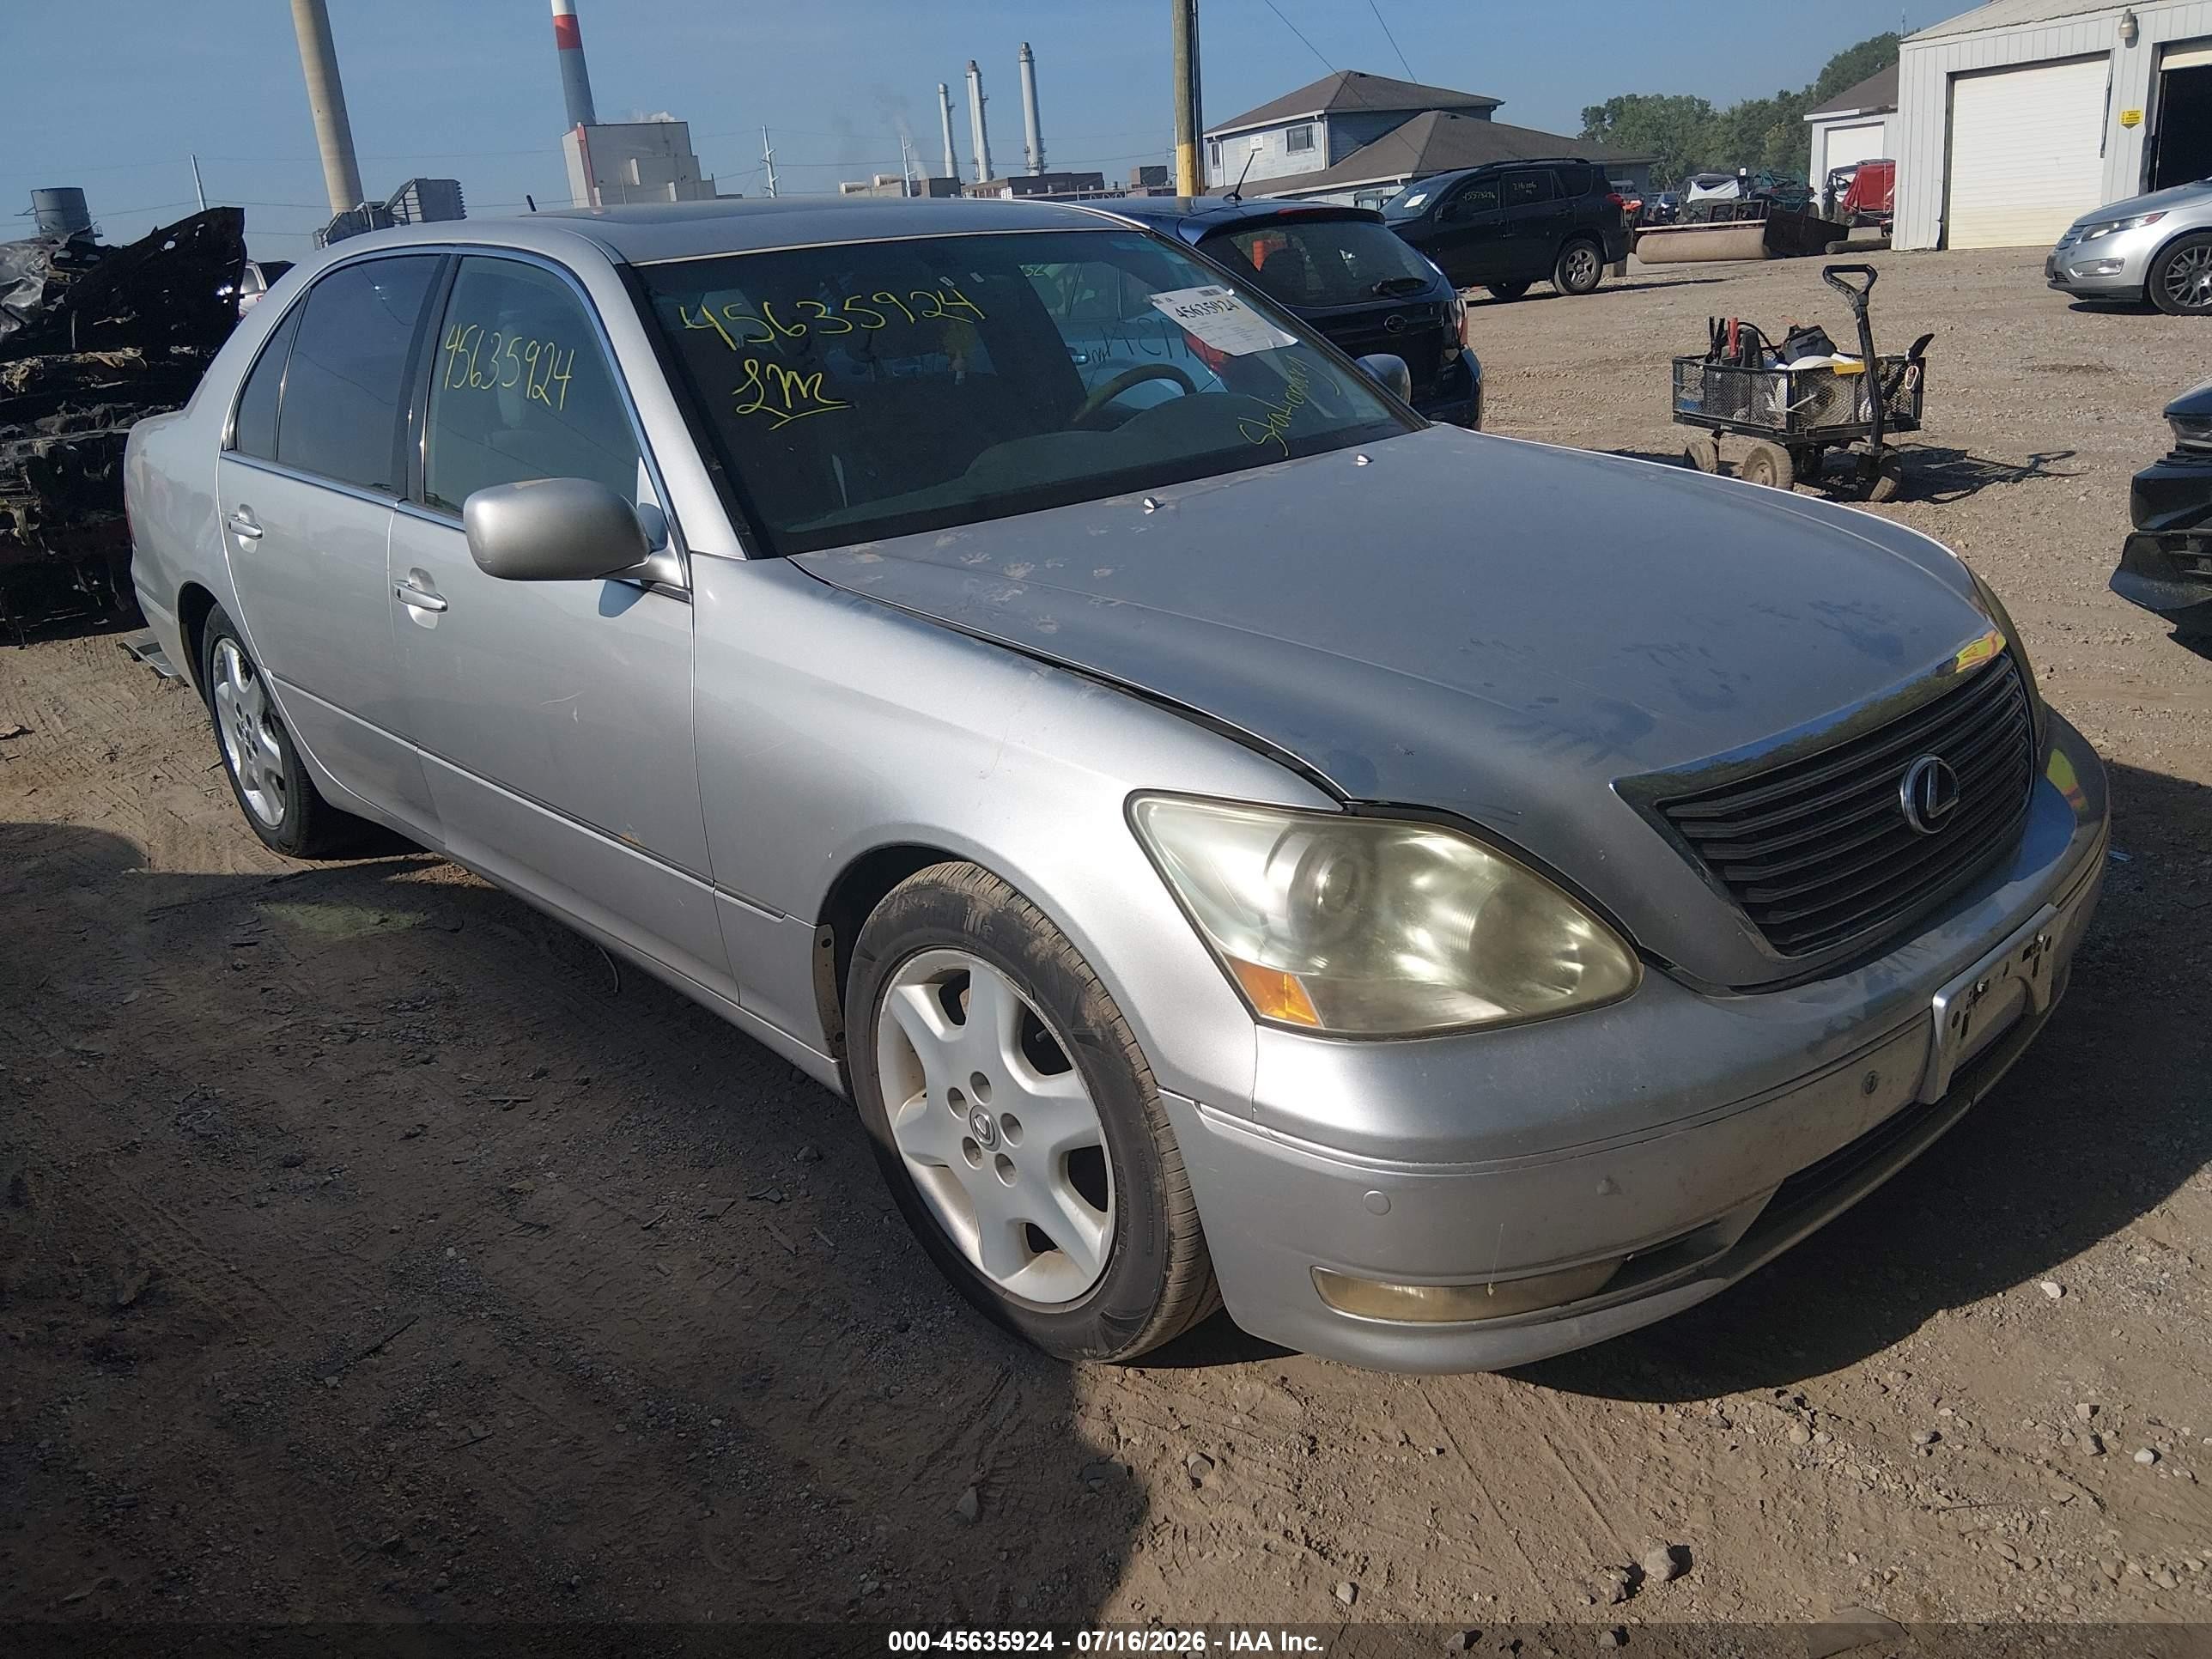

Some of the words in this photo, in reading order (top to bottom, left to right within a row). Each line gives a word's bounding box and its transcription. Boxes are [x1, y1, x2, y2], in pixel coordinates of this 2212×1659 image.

[678, 287, 988, 351] 45635924
[1174, 297, 1241, 319] 45635924
[444, 323, 575, 411] 45635924
